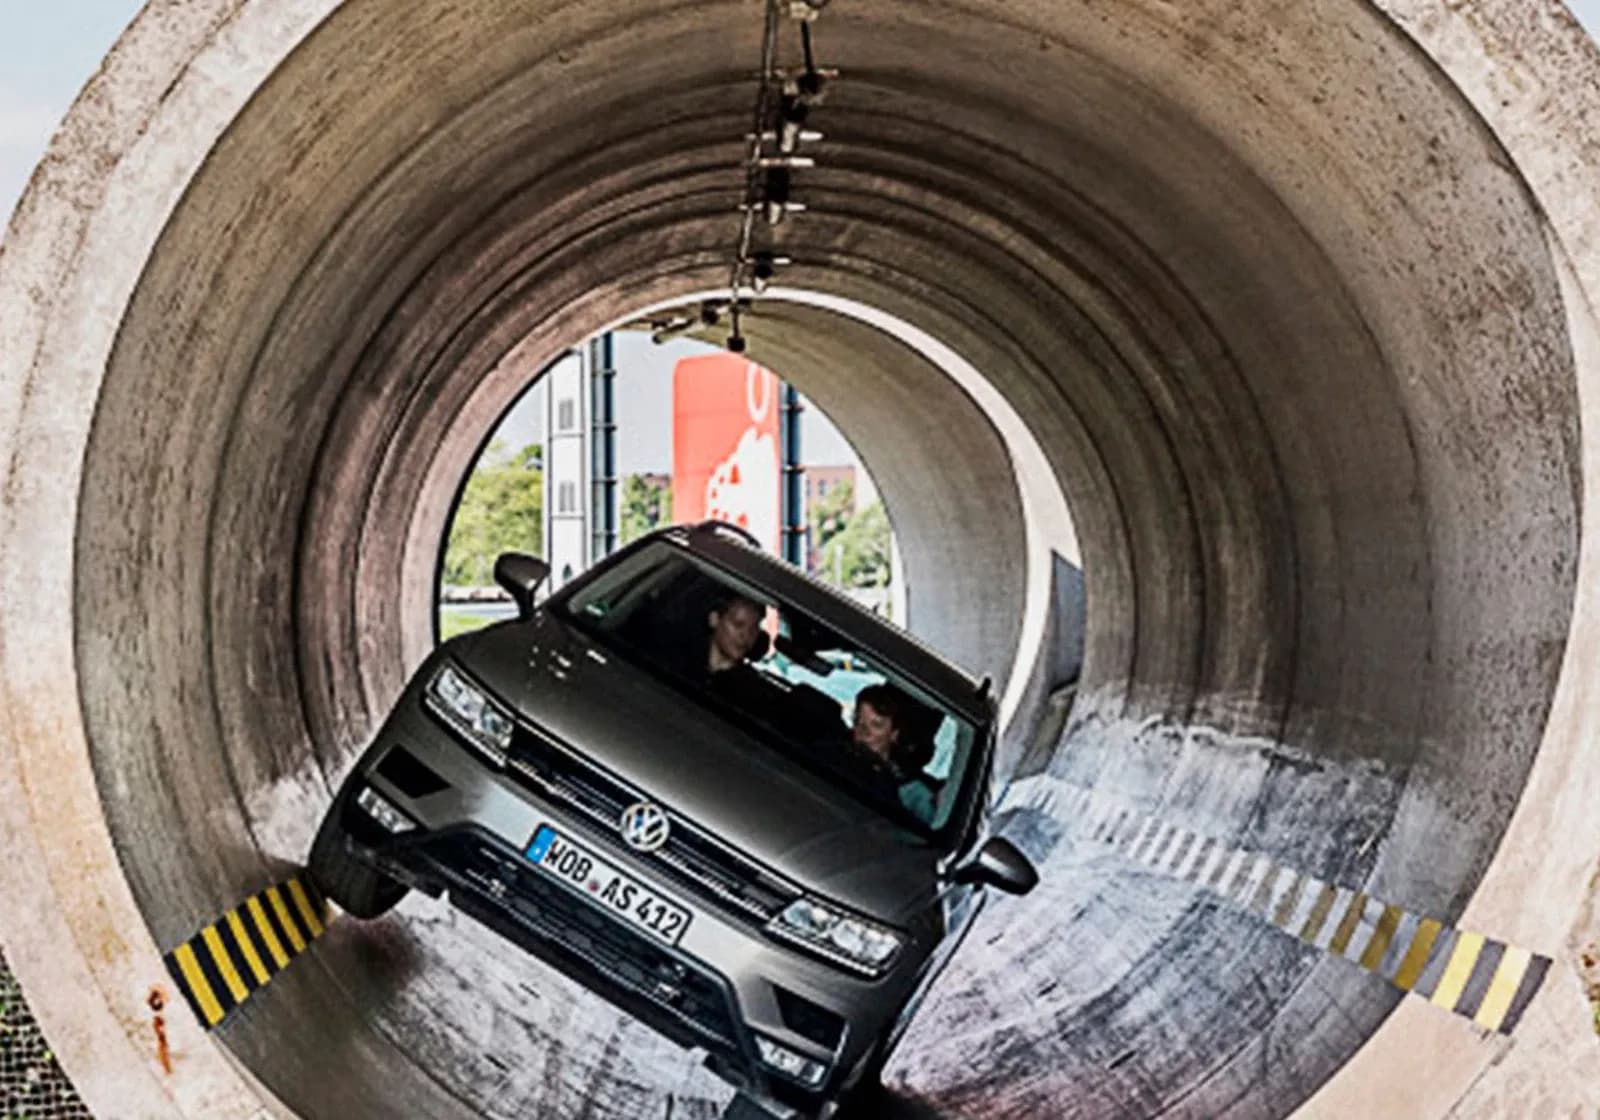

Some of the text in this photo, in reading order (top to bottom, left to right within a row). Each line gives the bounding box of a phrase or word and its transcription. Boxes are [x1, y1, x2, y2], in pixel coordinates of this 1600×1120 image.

[545, 840, 682, 938] WOB AS 412
